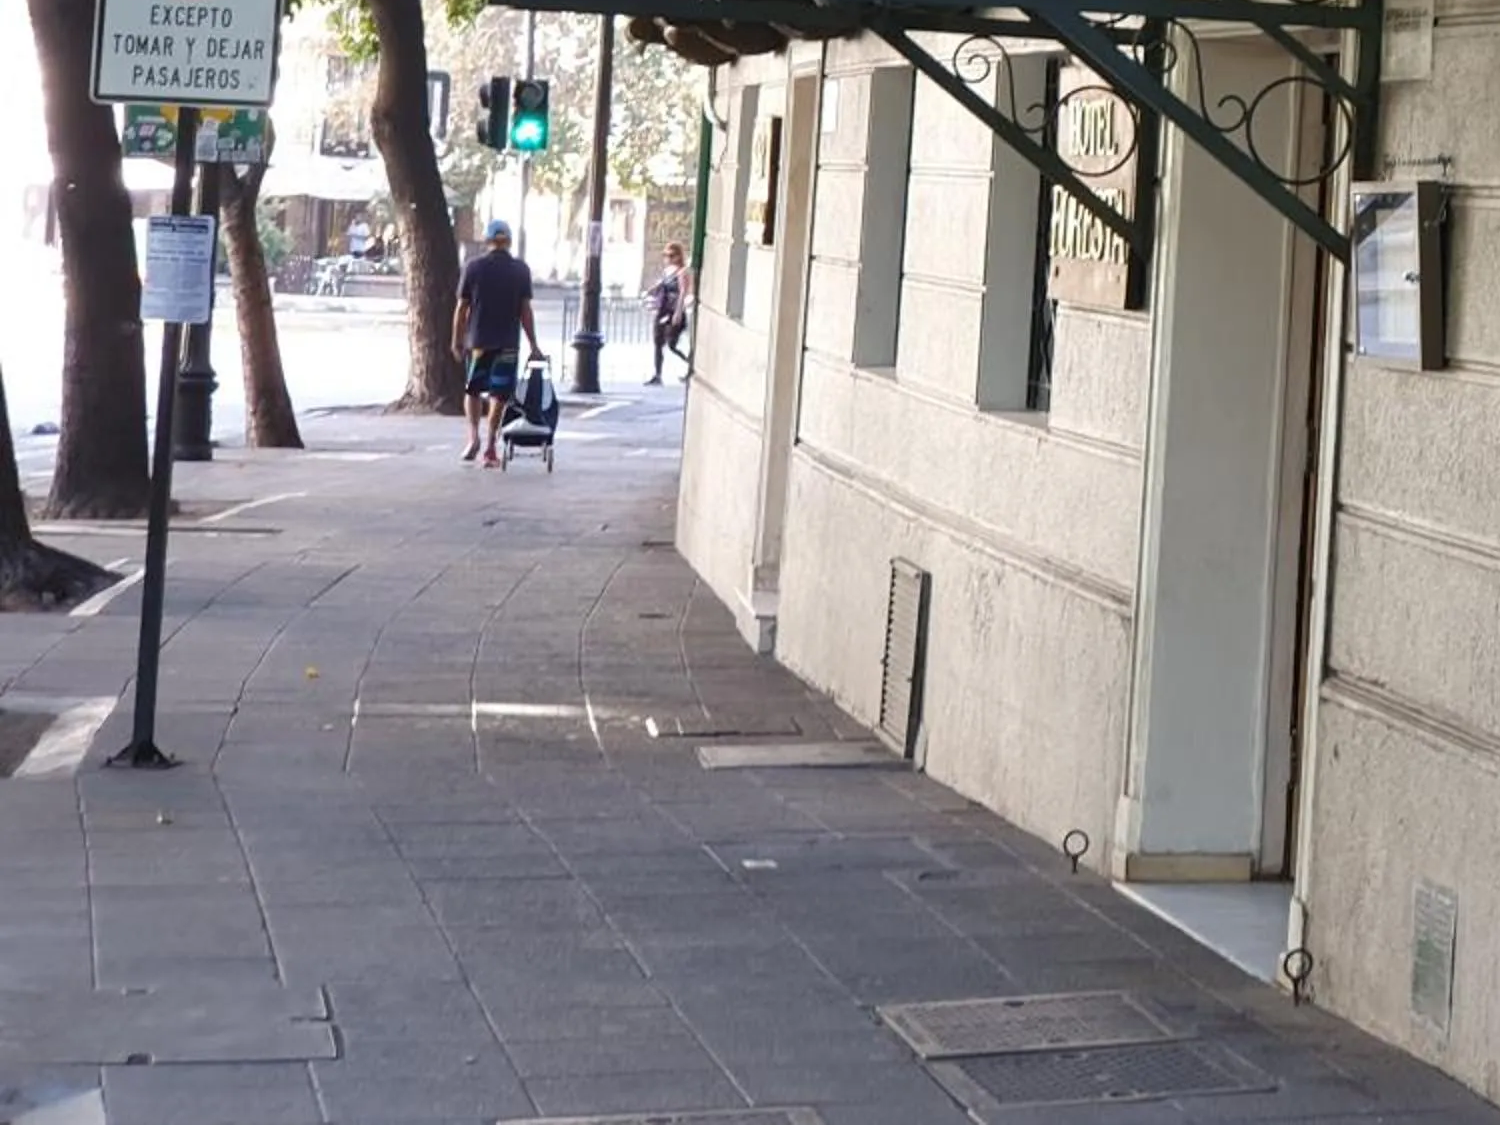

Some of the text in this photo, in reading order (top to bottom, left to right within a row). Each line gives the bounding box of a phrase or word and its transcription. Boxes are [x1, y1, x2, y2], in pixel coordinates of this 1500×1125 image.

[151, 5, 232, 28] EXCEPTO
[113, 33, 265, 63] TOMAR Y DEJAR
[131, 65, 241, 90] PASAJEROS
[1068, 98, 1118, 156] HOTEL
